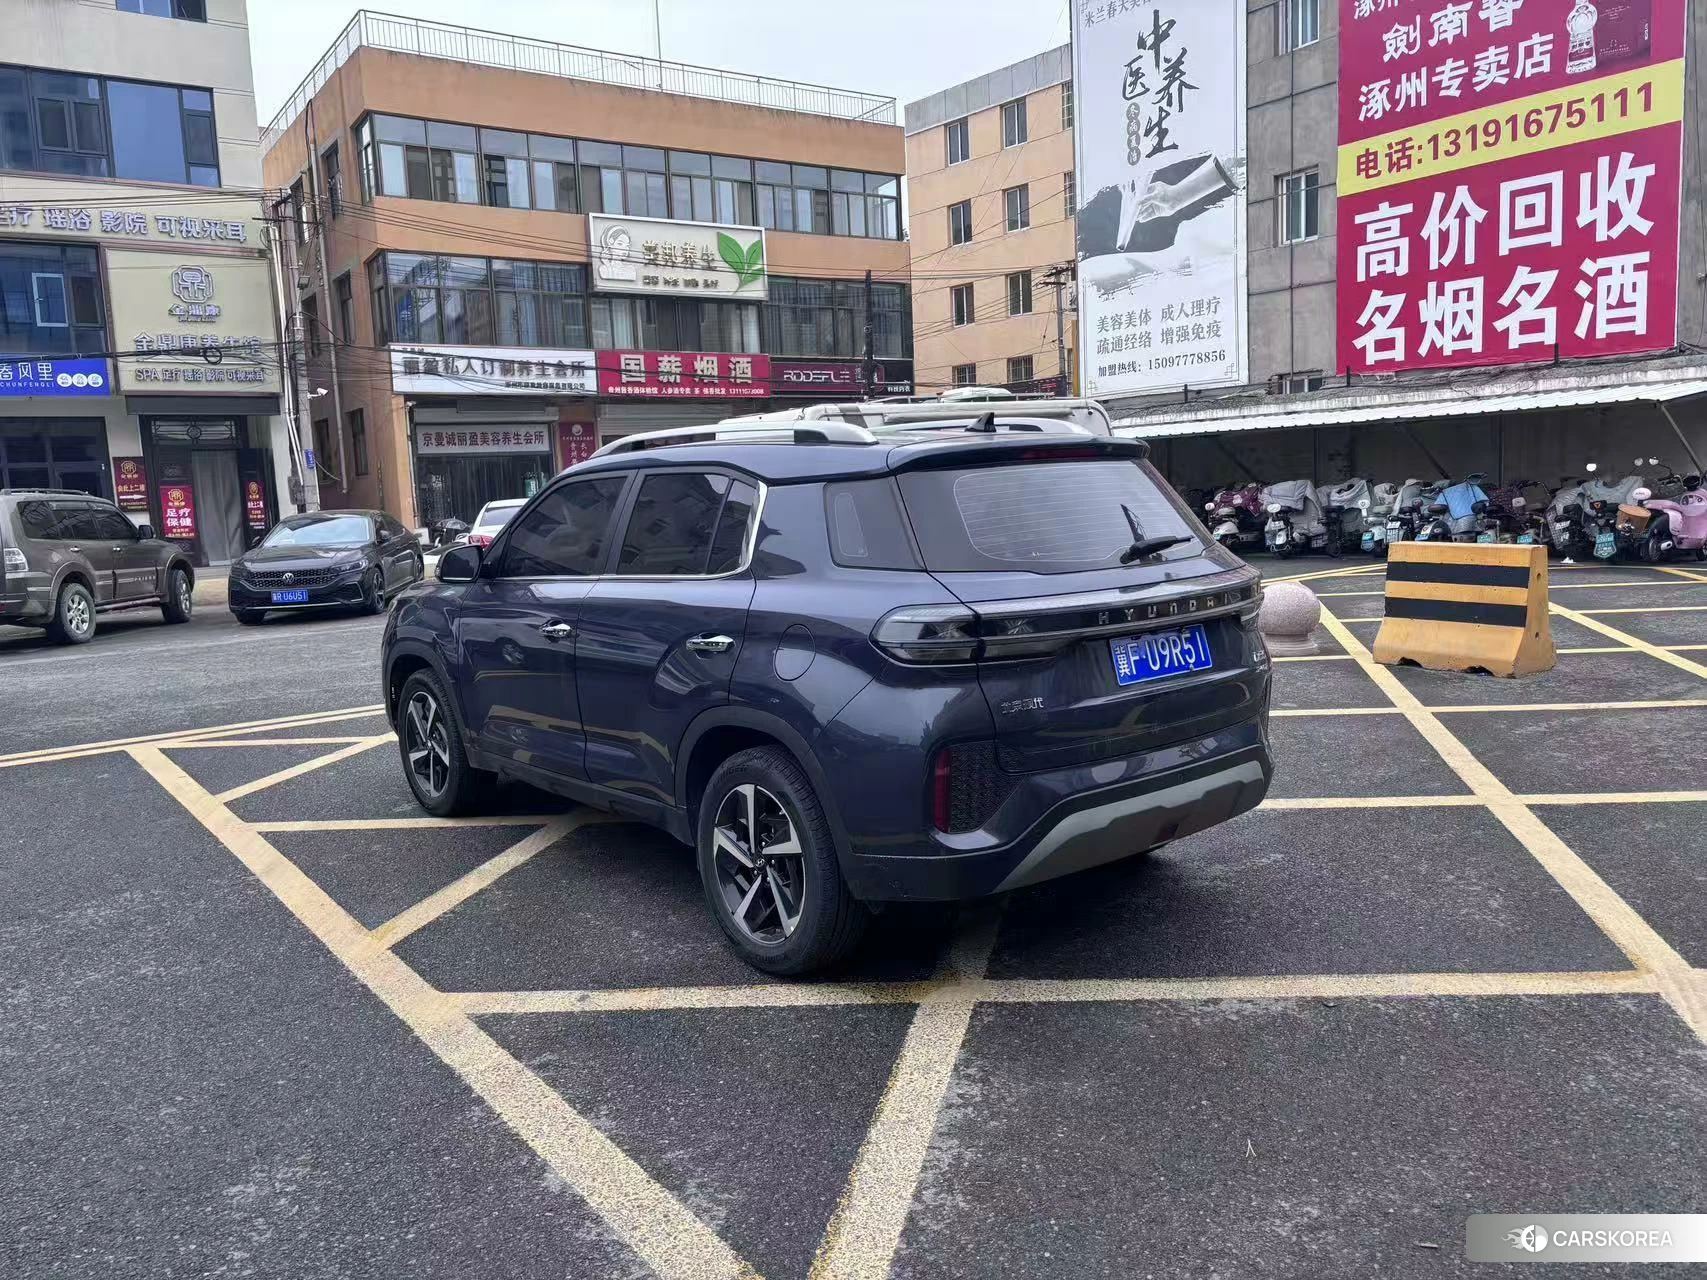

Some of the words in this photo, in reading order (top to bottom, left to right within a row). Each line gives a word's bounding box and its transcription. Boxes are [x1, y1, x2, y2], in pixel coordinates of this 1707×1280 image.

[1358, 32, 1553, 122] 涿州专卖店
[100, 210, 147, 234] 影院
[155, 215, 247, 243] 可视采耳
[1354, 152, 1656, 282] 高价回收
[1097, 308, 1151, 335] 美容美体
[1160, 296, 1221, 323] 成人理疗
[1352, 251, 1651, 365] 名烟名酒
[1097, 331, 1152, 355] 疏通经络
[1160, 320, 1222, 346] 增强免疫
[135, 368, 160, 381] SPA
[620, 353, 753, 384] 国薪烟酒
[1149, 350, 1226, 370] 15097778856
[422, 431, 544, 447] 京曼诚丽盈美容养生会所
